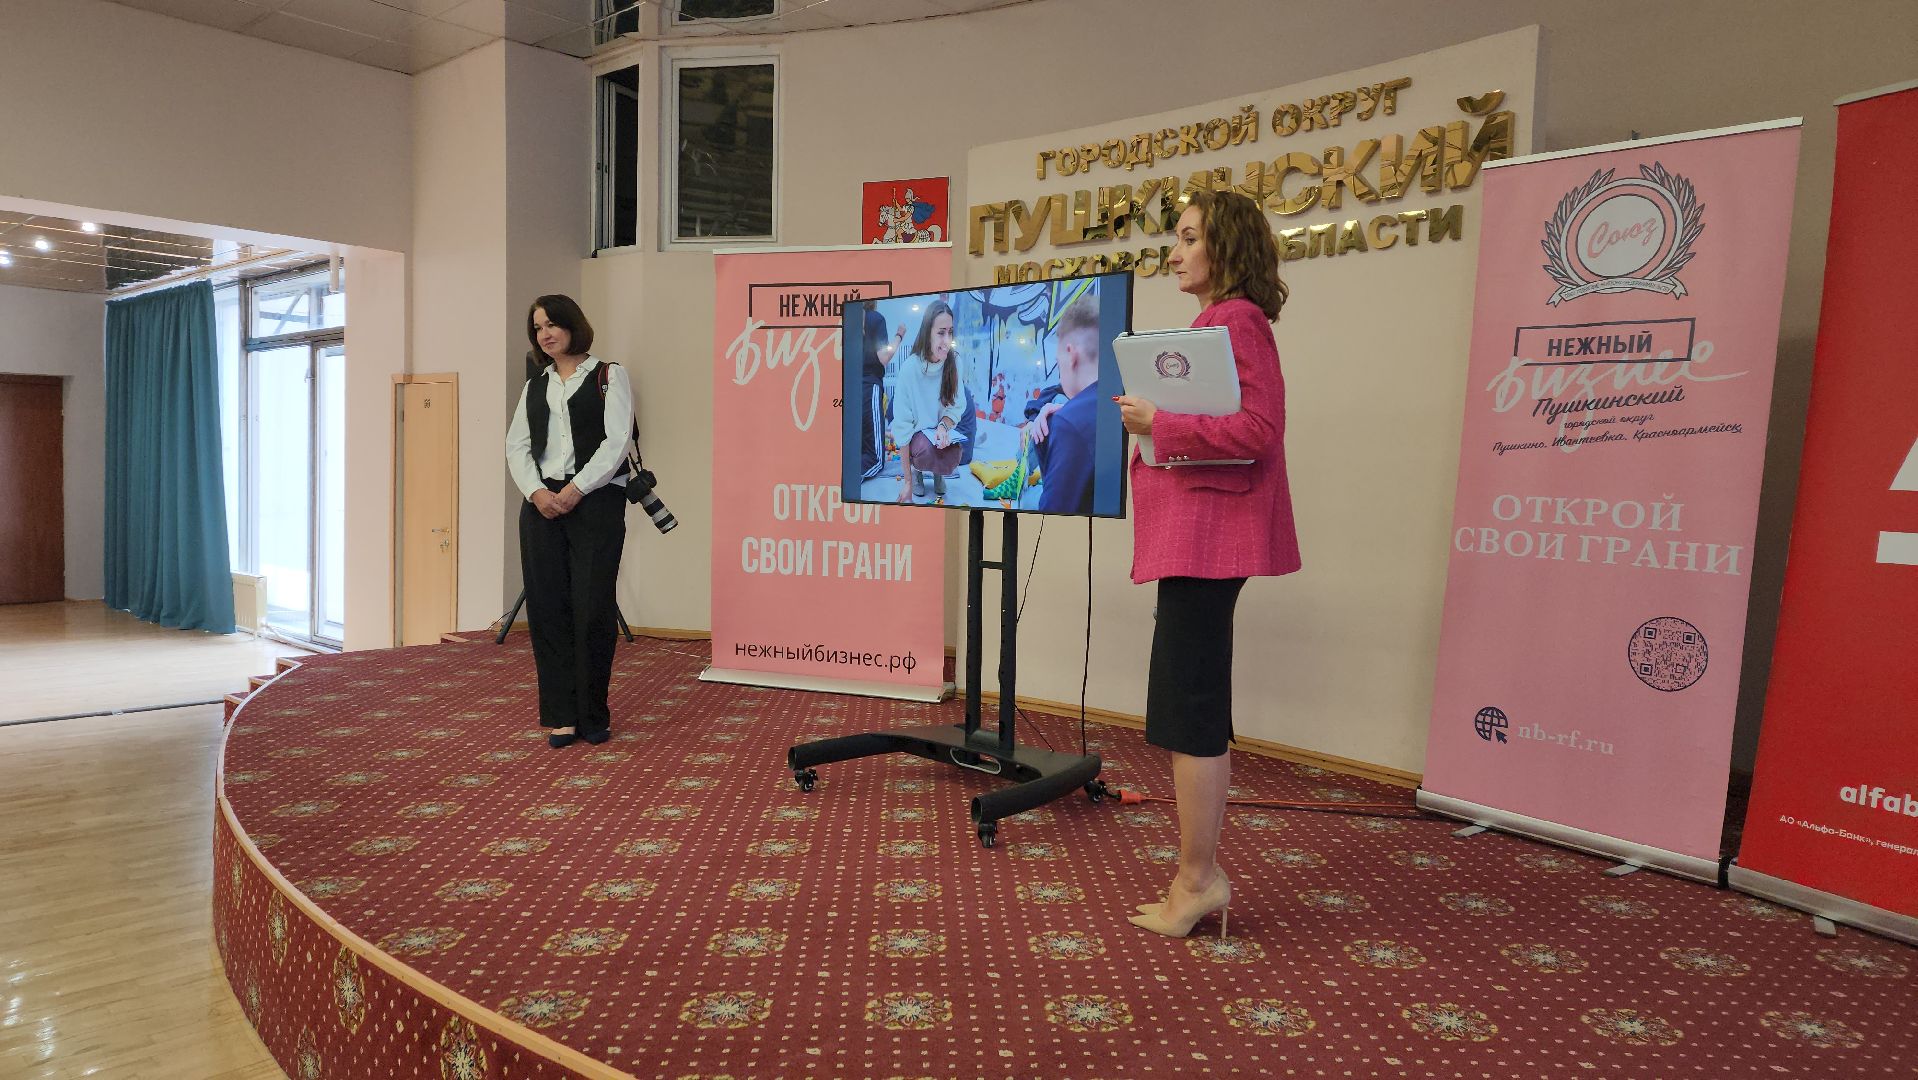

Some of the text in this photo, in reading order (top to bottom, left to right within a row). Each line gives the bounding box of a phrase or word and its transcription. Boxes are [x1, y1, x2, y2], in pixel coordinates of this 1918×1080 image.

[1036, 77, 1412, 180] ГОРОДСКОЙ ОКРУГ
[992, 205, 1464, 287] МОСКОВС БЛАСТИ
[1587, 217, 1658, 260] Союз
[1547, 330, 1654, 357] НЕЖНЫЙ
[1532, 384, 1687, 425] Пушкинский
[1563, 413, 1655, 431] городской округ
[1492, 491, 1685, 532] ОТКРОЙ
[742, 536, 913, 582] СВОИ ГРАНИ
[1454, 526, 1744, 576] СВОИ ГРАНИ
[735, 642, 917, 675] нежныйбизнес.рф
[1518, 723, 1616, 756] nb-rf.ru
[1779, 814, 1795, 825] АО
